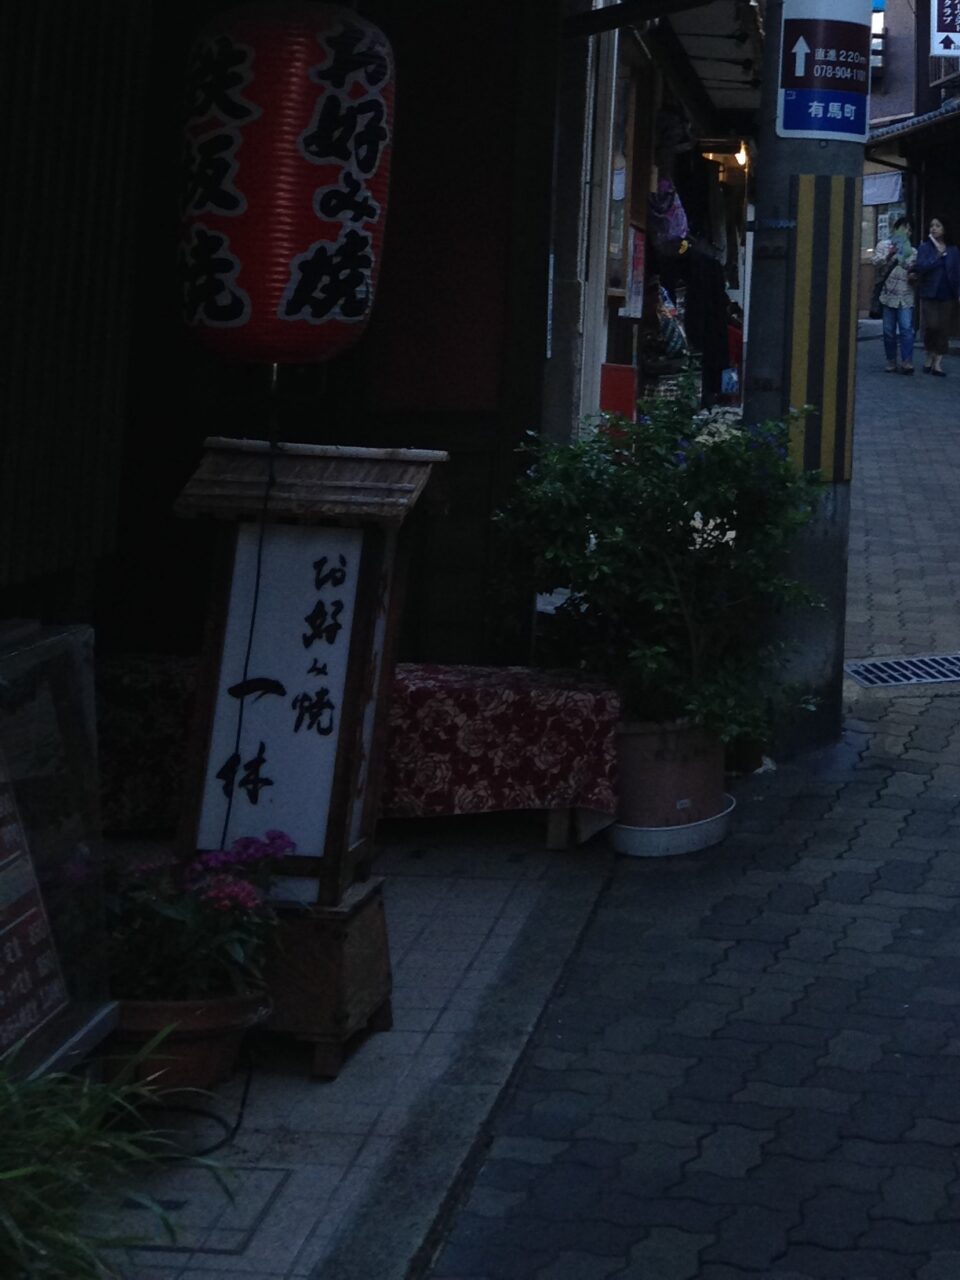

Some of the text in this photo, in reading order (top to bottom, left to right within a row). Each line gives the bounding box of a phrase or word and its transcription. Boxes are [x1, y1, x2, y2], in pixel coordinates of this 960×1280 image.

[942, 0, 954, 25] クラブ
[813, 65, 866, 81] 078-904-1
[808, 101, 857, 120] 有馬町
[284, 23, 393, 324] お好み焼
